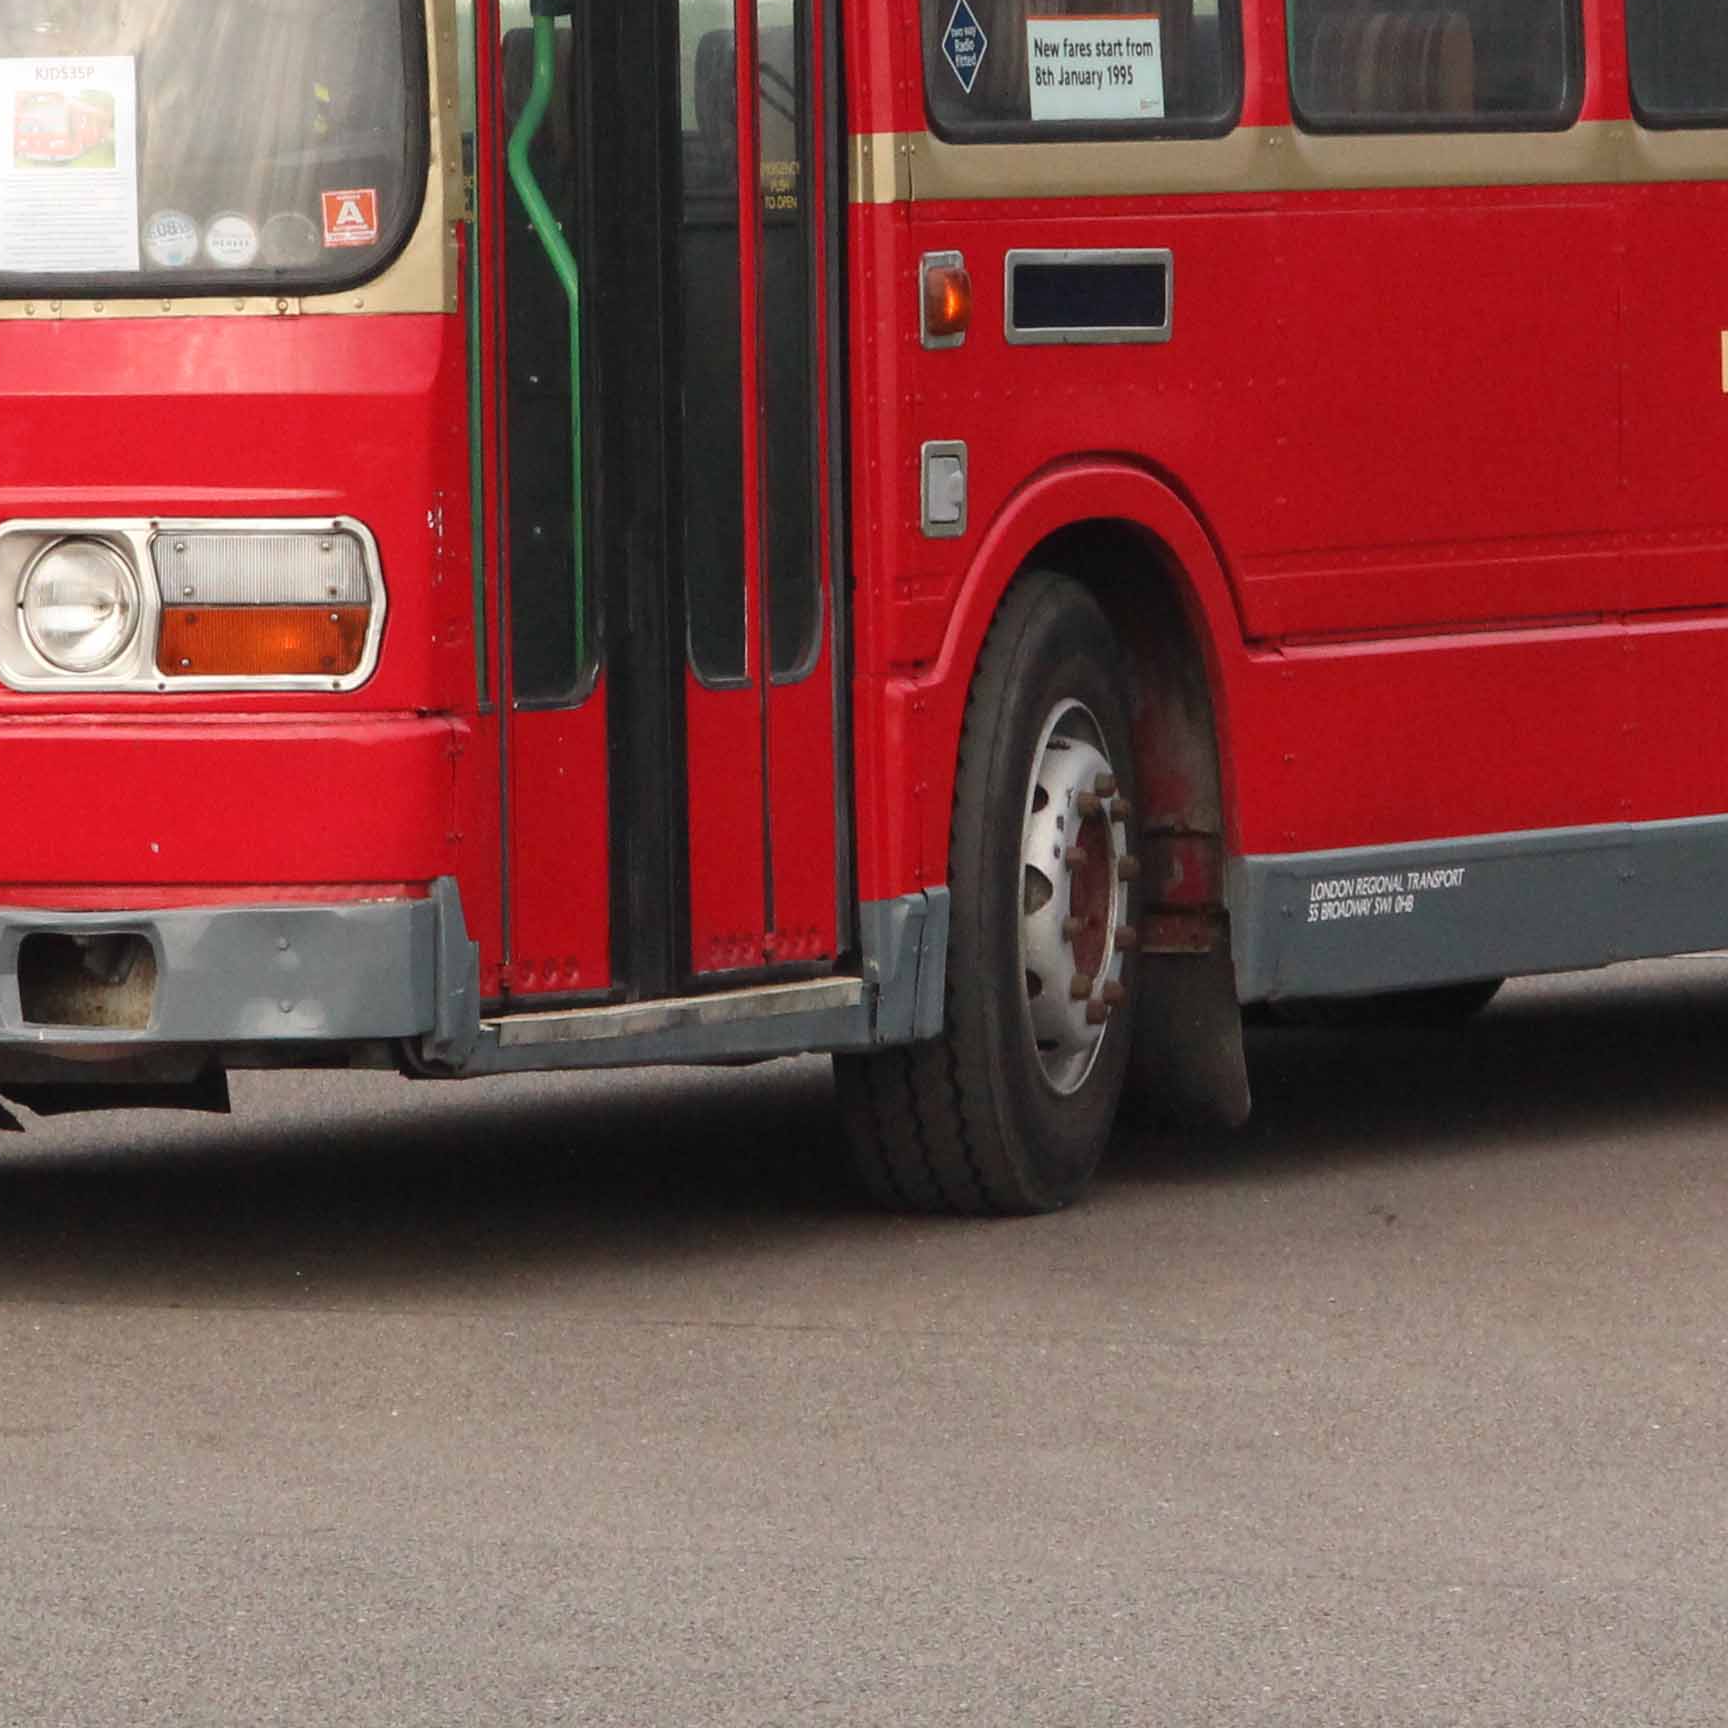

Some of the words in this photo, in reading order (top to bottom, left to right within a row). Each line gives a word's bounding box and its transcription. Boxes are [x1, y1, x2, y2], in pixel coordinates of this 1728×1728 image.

[1034, 38, 1060, 58] New
[1063, 37, 1092, 57] fares
[1095, 39, 1123, 57] start
[1126, 37, 1154, 57] from
[1035, 65, 1055, 86] 8th
[1058, 65, 1103, 91] January
[1107, 64, 1134, 85] 1995
[1310, 878, 1355, 901] LONDON
[1355, 874, 1404, 896] REGIONAL
[1407, 868, 1466, 890] TRANSPORT
[1320, 898, 1373, 921] BROADWAY
[1373, 895, 1393, 915] SW1
